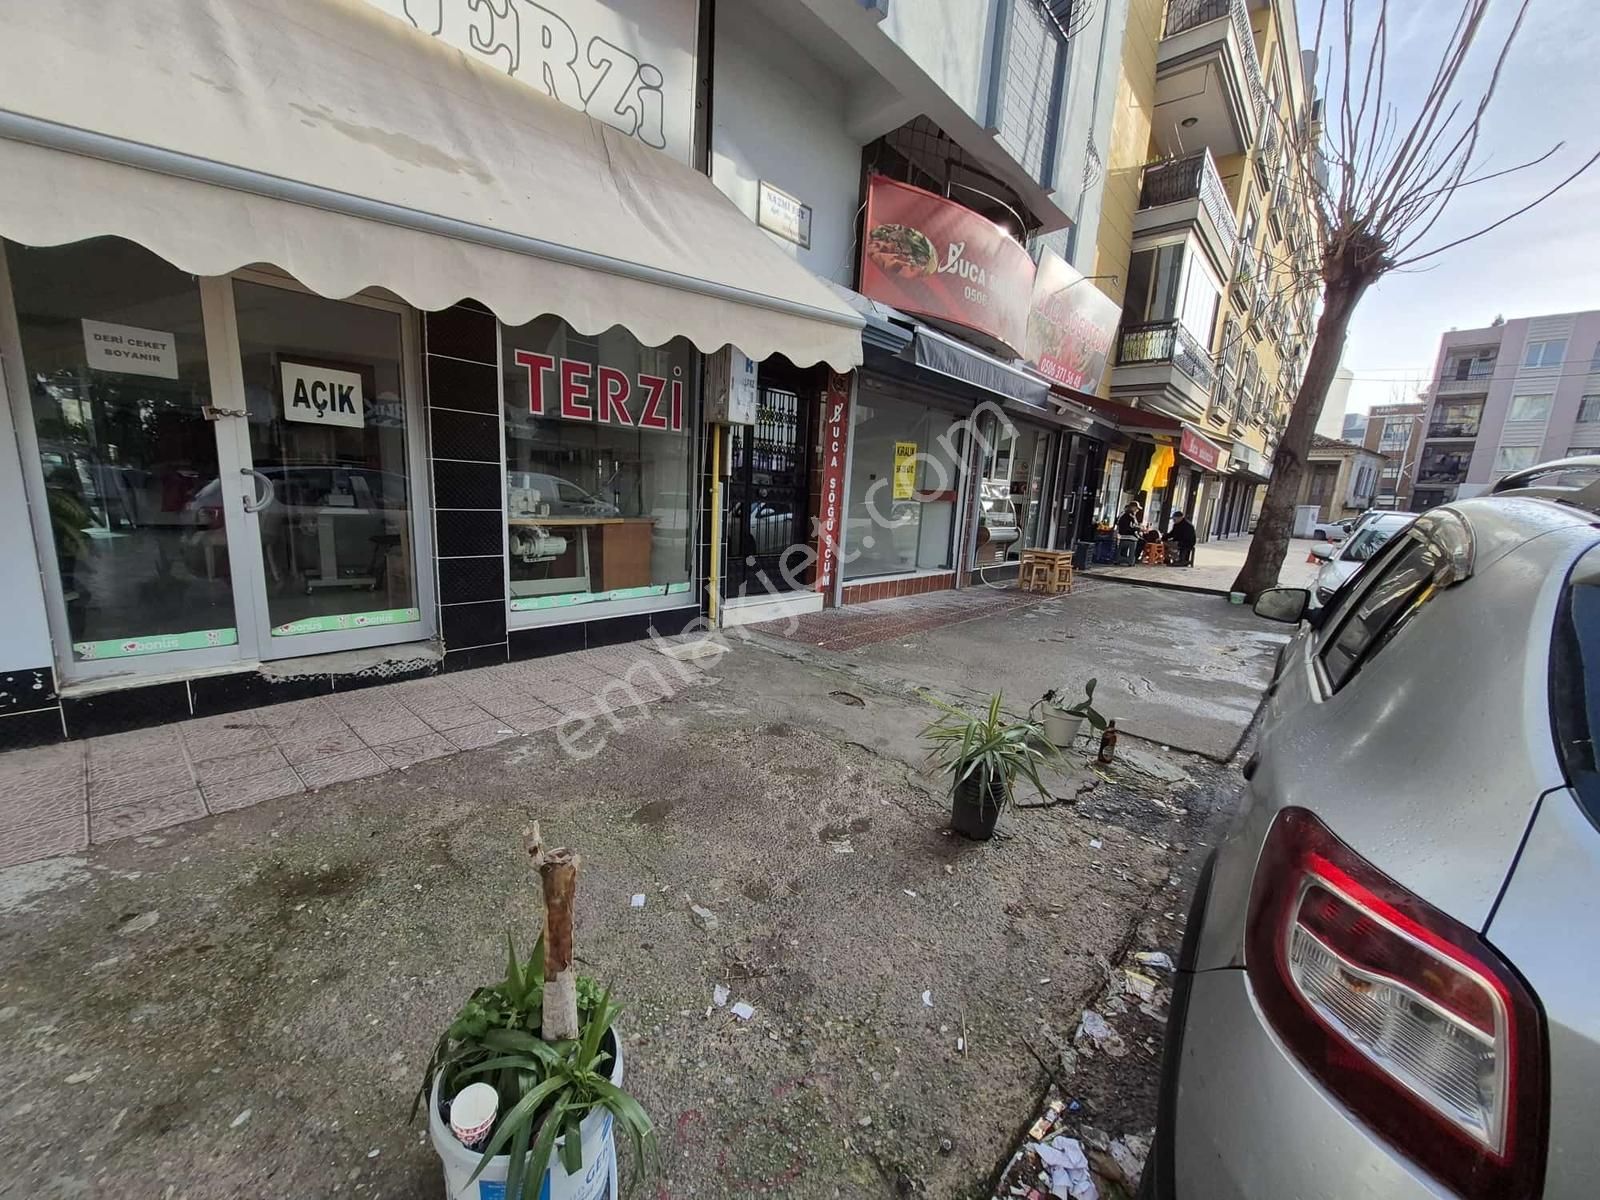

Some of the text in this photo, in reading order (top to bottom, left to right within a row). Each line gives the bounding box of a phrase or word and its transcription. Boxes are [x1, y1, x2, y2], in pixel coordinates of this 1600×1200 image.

[937, 241, 986, 288] BUCA
[93, 332, 168, 351] DERİ CEKET
[104, 348, 161, 363] BOYANIR
[292, 378, 358, 418] AÇIK
[513, 348, 684, 433] TERZİ
[829, 403, 844, 467] BUCA
